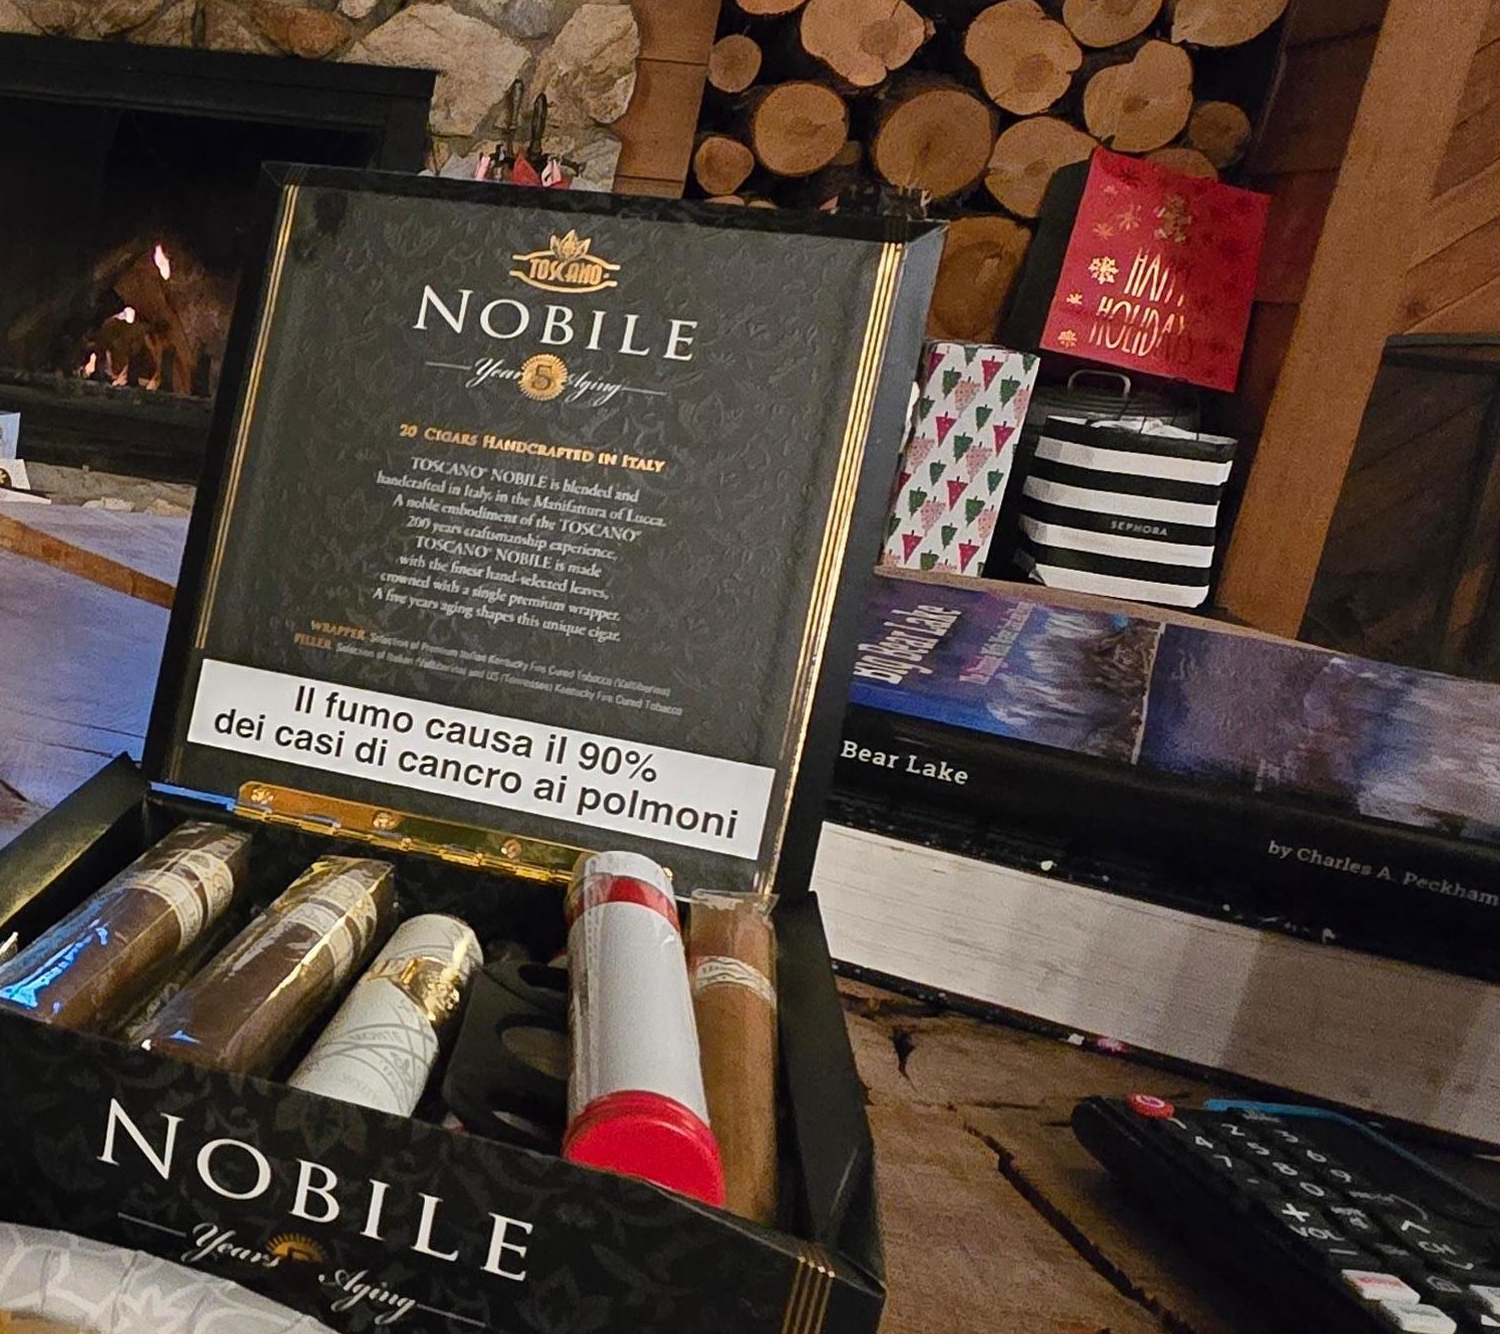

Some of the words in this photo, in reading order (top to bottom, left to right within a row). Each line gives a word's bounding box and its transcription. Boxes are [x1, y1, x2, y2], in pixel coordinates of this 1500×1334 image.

[412, 284, 698, 362] NOBILE
[400, 423, 418, 438] 20
[598, 453, 617, 465] IN
[376, 470, 446, 494] handcrafted
[448, 481, 461, 496] in
[495, 490, 509, 504] in
[511, 492, 530, 506] the
[533, 495, 607, 518] Manifattura
[610, 508, 626, 521] of
[490, 469, 547, 489] NOBILE
[550, 478, 560, 490] is
[563, 479, 612, 499] blended
[615, 489, 639, 503] and
[392, 494, 403, 508] A
[406, 497, 440, 513] noble
[441, 503, 517, 524] embodiment
[520, 513, 534, 527] of
[536, 517, 556, 531] the
[406, 515, 431, 529] 200
[432, 520, 462, 535] years
[1111, 520, 1168, 536] SEPHORA
[399, 555, 426, 568] with
[429, 558, 449, 572] the
[451, 561, 484, 578] finest
[494, 548, 552, 569] NOBILE
[555, 559, 564, 571] is
[568, 563, 602, 578] made
[380, 572, 431, 589] crowned
[433, 579, 460, 594] with
[462, 587, 470, 596] a
[472, 586, 506, 604] single
[508, 595, 565, 612] premium
[372, 587, 383, 600] A
[386, 588, 407, 604] five
[408, 596, 439, 609] years
[440, 602, 473, 618] aging
[476, 605, 515, 624] shapes
[517, 612, 540, 628] this
[542, 619, 586, 637] unique
[884, 604, 962, 637] Lake
[858, 630, 940, 662] Bear
[295, 685, 315, 714] Il
[324, 692, 413, 733] fumo
[426, 718, 531, 758] causa
[545, 734, 567, 764] il
[579, 741, 658, 783] 90%
[213, 708, 264, 741] dei
[274, 720, 342, 757] casi
[355, 737, 386, 767] di
[399, 750, 523, 794] cancro
[534, 772, 565, 805] ai
[577, 783, 739, 839] polmoni
[840, 740, 900, 769] Bear
[906, 755, 969, 785] Lake
[1268, 840, 1293, 859] by
[1297, 848, 1372, 876] Charles
[1403, 871, 1499, 907] Peckham
[1195, 1135, 1214, 1149] 4
[1221, 1123, 1245, 1137] 2
[1273, 1129, 1299, 1143] 3
[1213, 1154, 1232, 1168] 7
[1247, 1141, 1270, 1155] 5
[1306, 1149, 1327, 1163] 6
[1272, 1162, 1298, 1176] 8
[1330, 1169, 1352, 1182] 9
[96, 1098, 534, 1282] NOBILE
[1300, 1182, 1325, 1197] 0
[1289, 1224, 1346, 1241] VOL
[181, 1222, 281, 1267] Years
[318, 1268, 418, 1325] Aging
